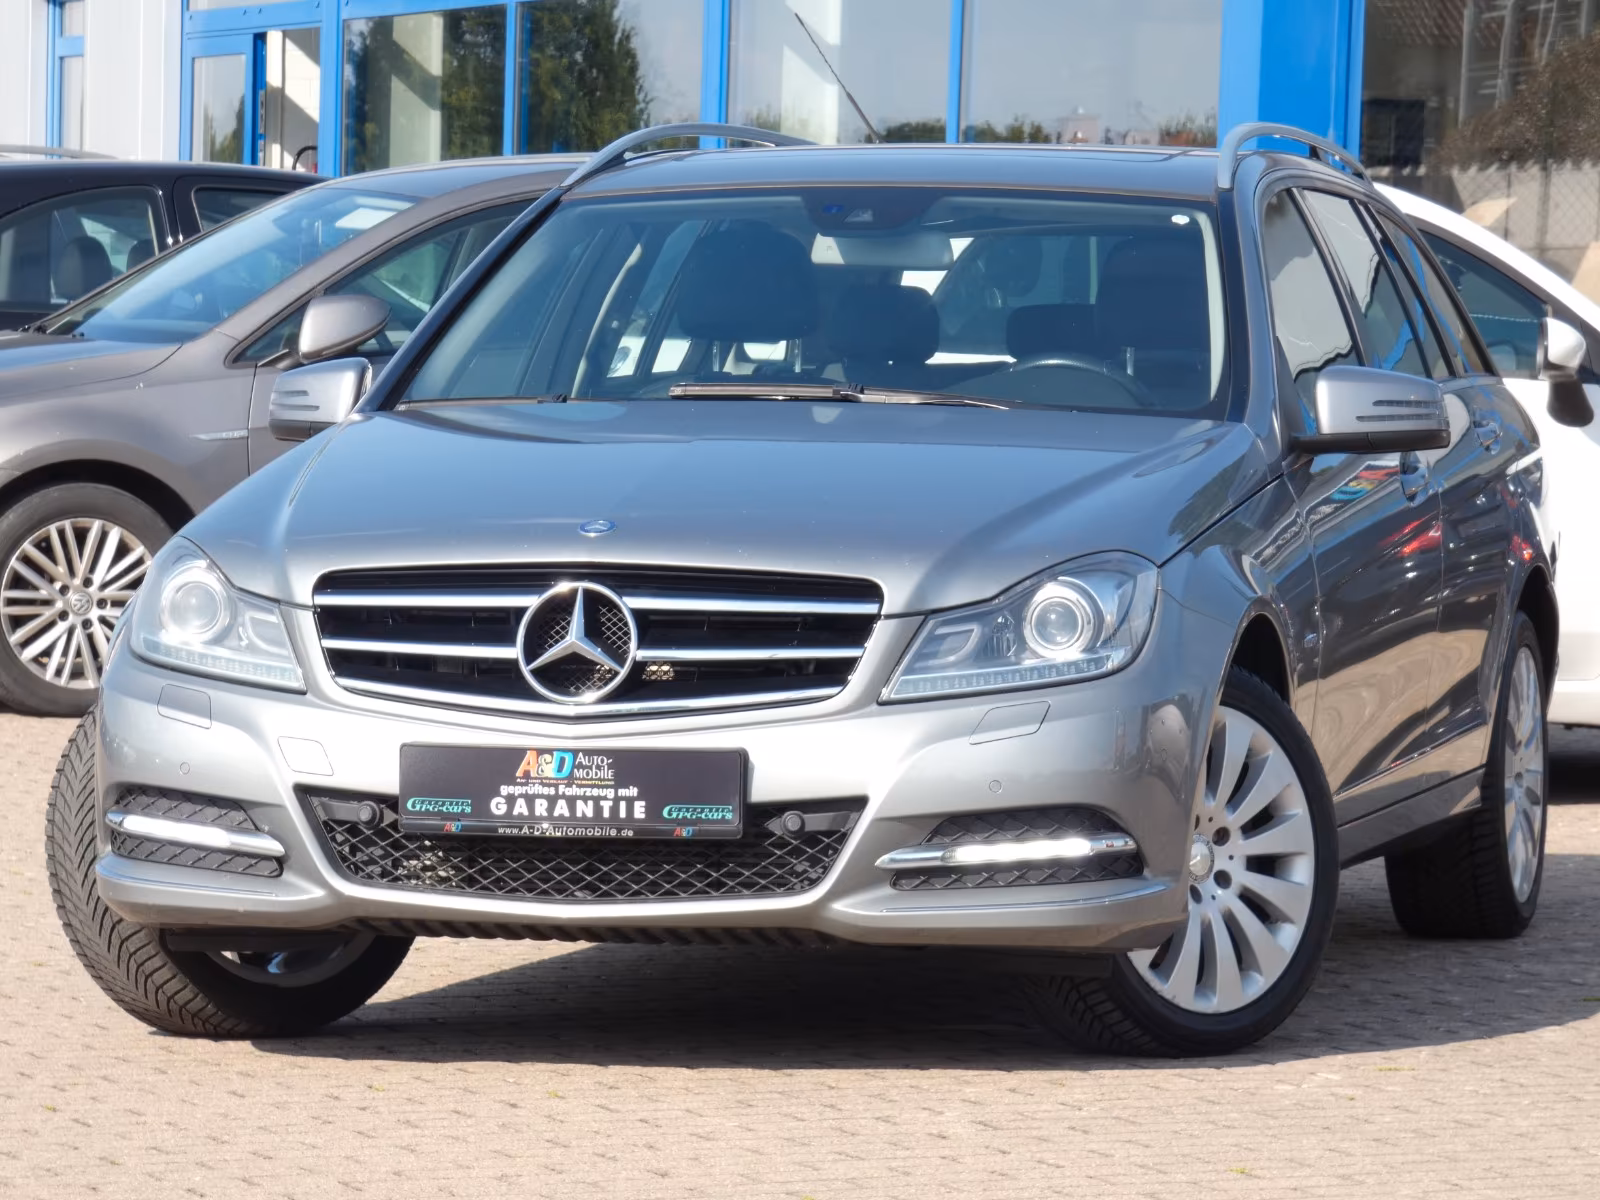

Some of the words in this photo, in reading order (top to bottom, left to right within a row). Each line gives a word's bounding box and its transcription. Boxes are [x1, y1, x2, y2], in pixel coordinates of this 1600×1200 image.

[515, 750, 574, 778] A&D
[500, 784, 556, 796] geprüftes
[559, 785, 615, 799] Fahrzeug
[618, 786, 639, 797] mit
[490, 797, 647, 819] GARANTIE
[498, 825, 634, 837] www.A-D-Automobile.de
